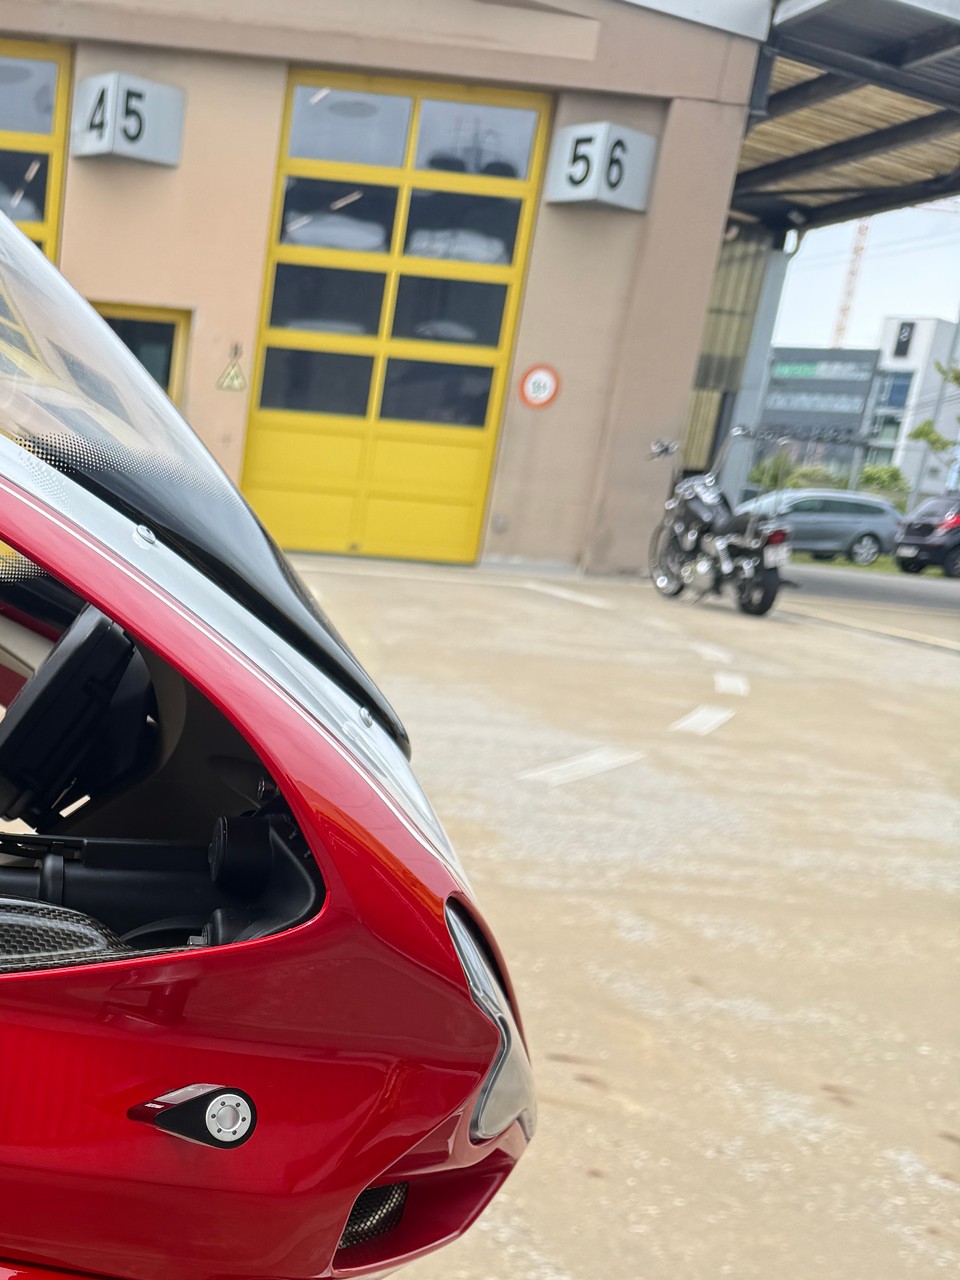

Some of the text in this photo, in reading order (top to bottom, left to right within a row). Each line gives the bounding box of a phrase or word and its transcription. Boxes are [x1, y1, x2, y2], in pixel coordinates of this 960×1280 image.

[88, 86, 106, 141] 4
[122, 88, 145, 143] 5
[568, 136, 594, 187] 5
[606, 138, 627, 191] 6
